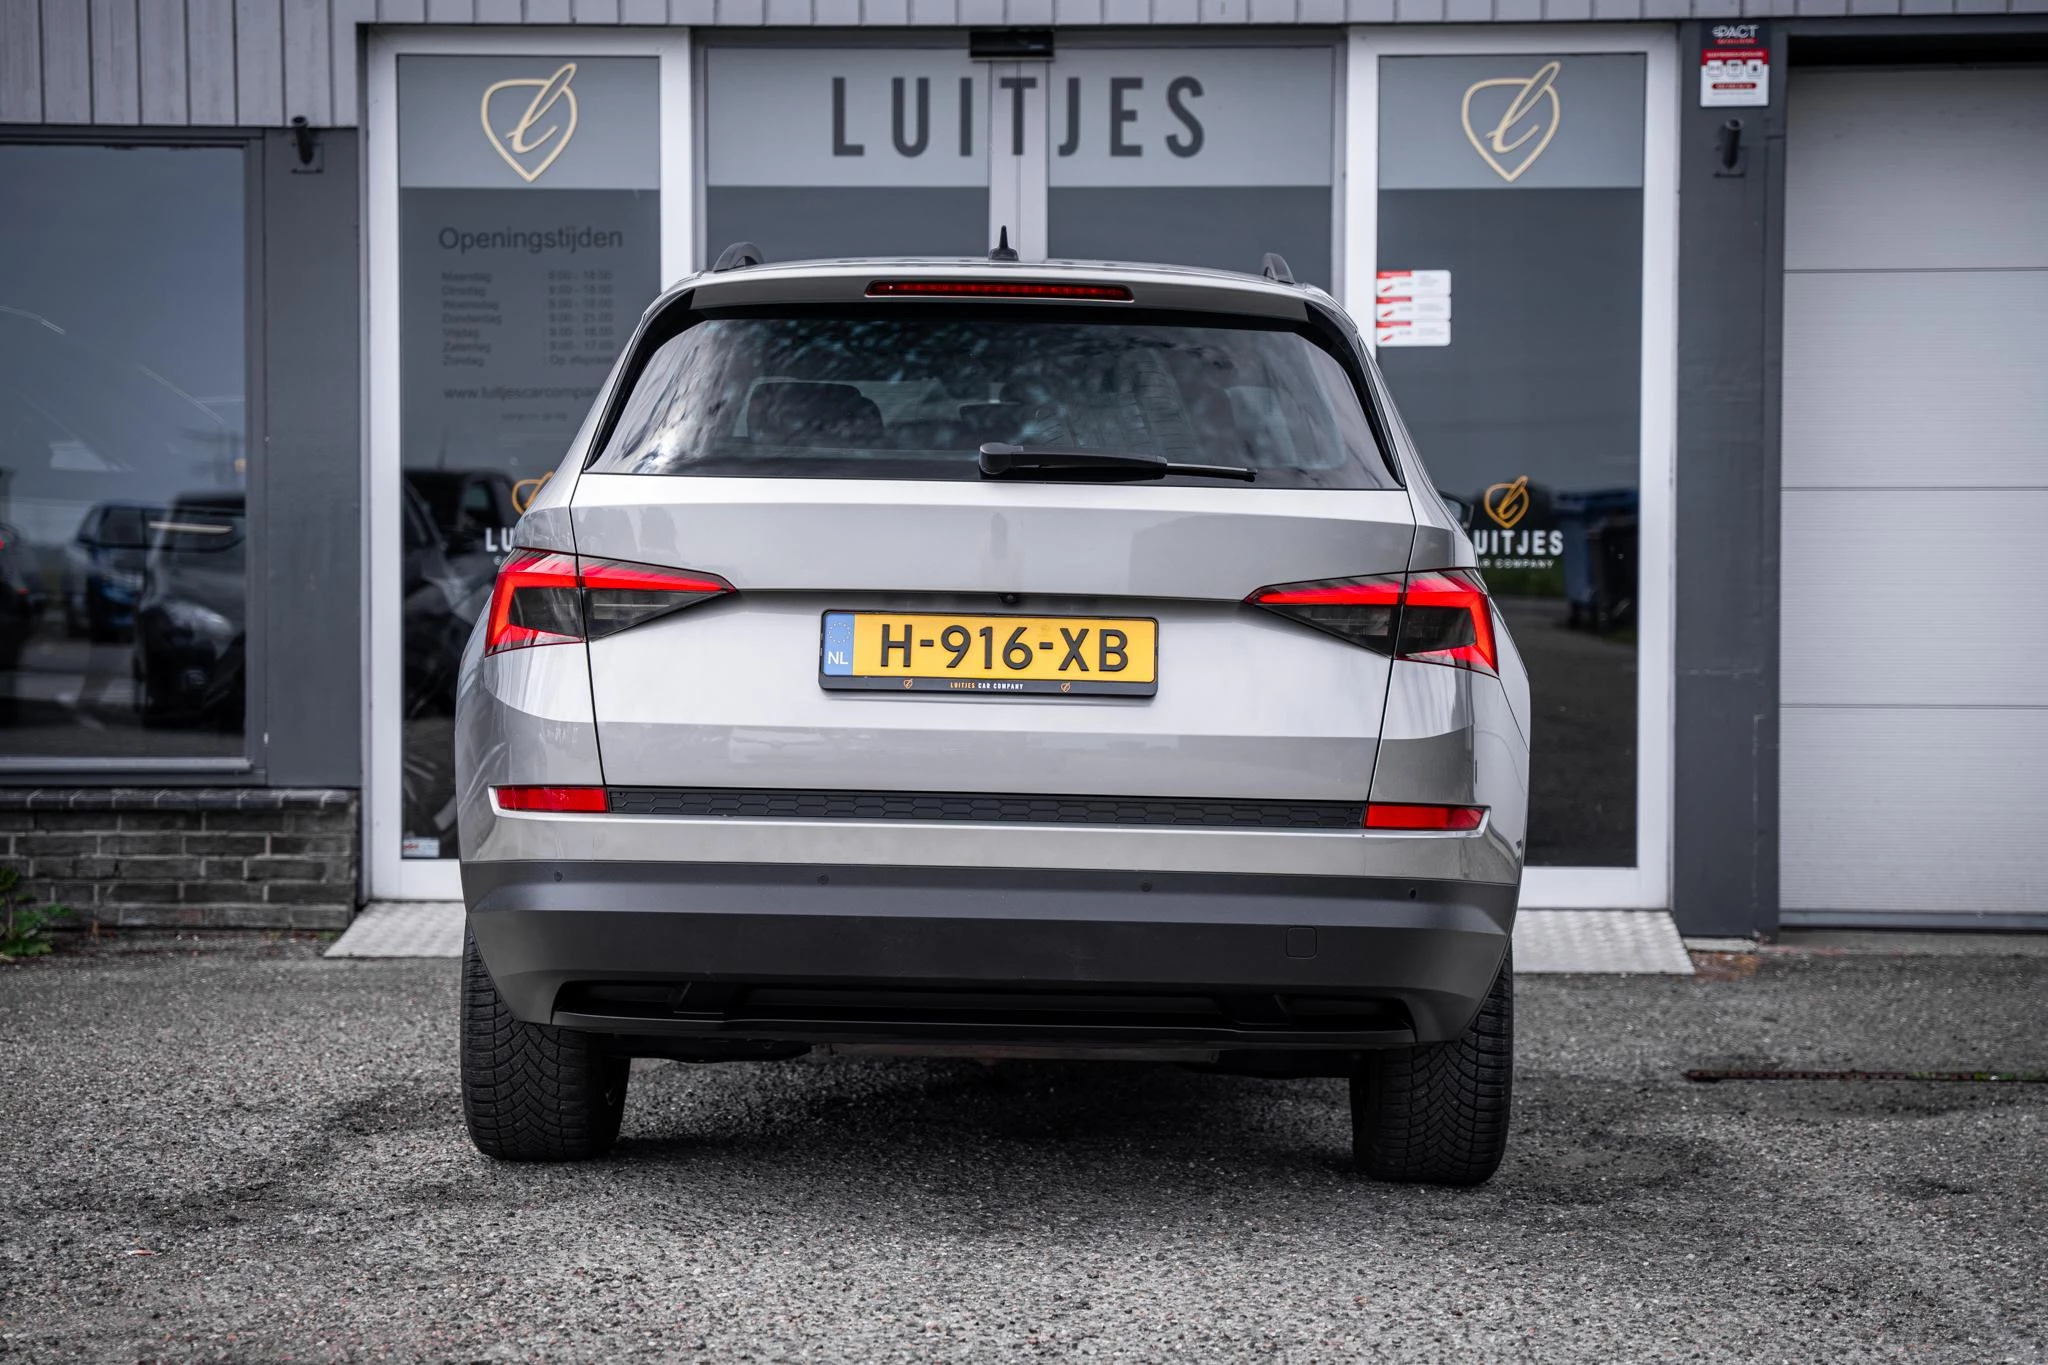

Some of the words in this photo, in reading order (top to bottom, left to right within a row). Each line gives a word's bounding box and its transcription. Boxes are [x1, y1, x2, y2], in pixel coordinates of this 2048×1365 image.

[832, 75, 1205, 158] LUITJES
[438, 226, 623, 255] Openingstijden
[1474, 529, 1564, 556] UITJES
[1495, 558, 1555, 568] COMPANY
[827, 651, 848, 665] NL
[879, 623, 1129, 672] H-916-XB
[950, 681, 976, 689] LUITJES
